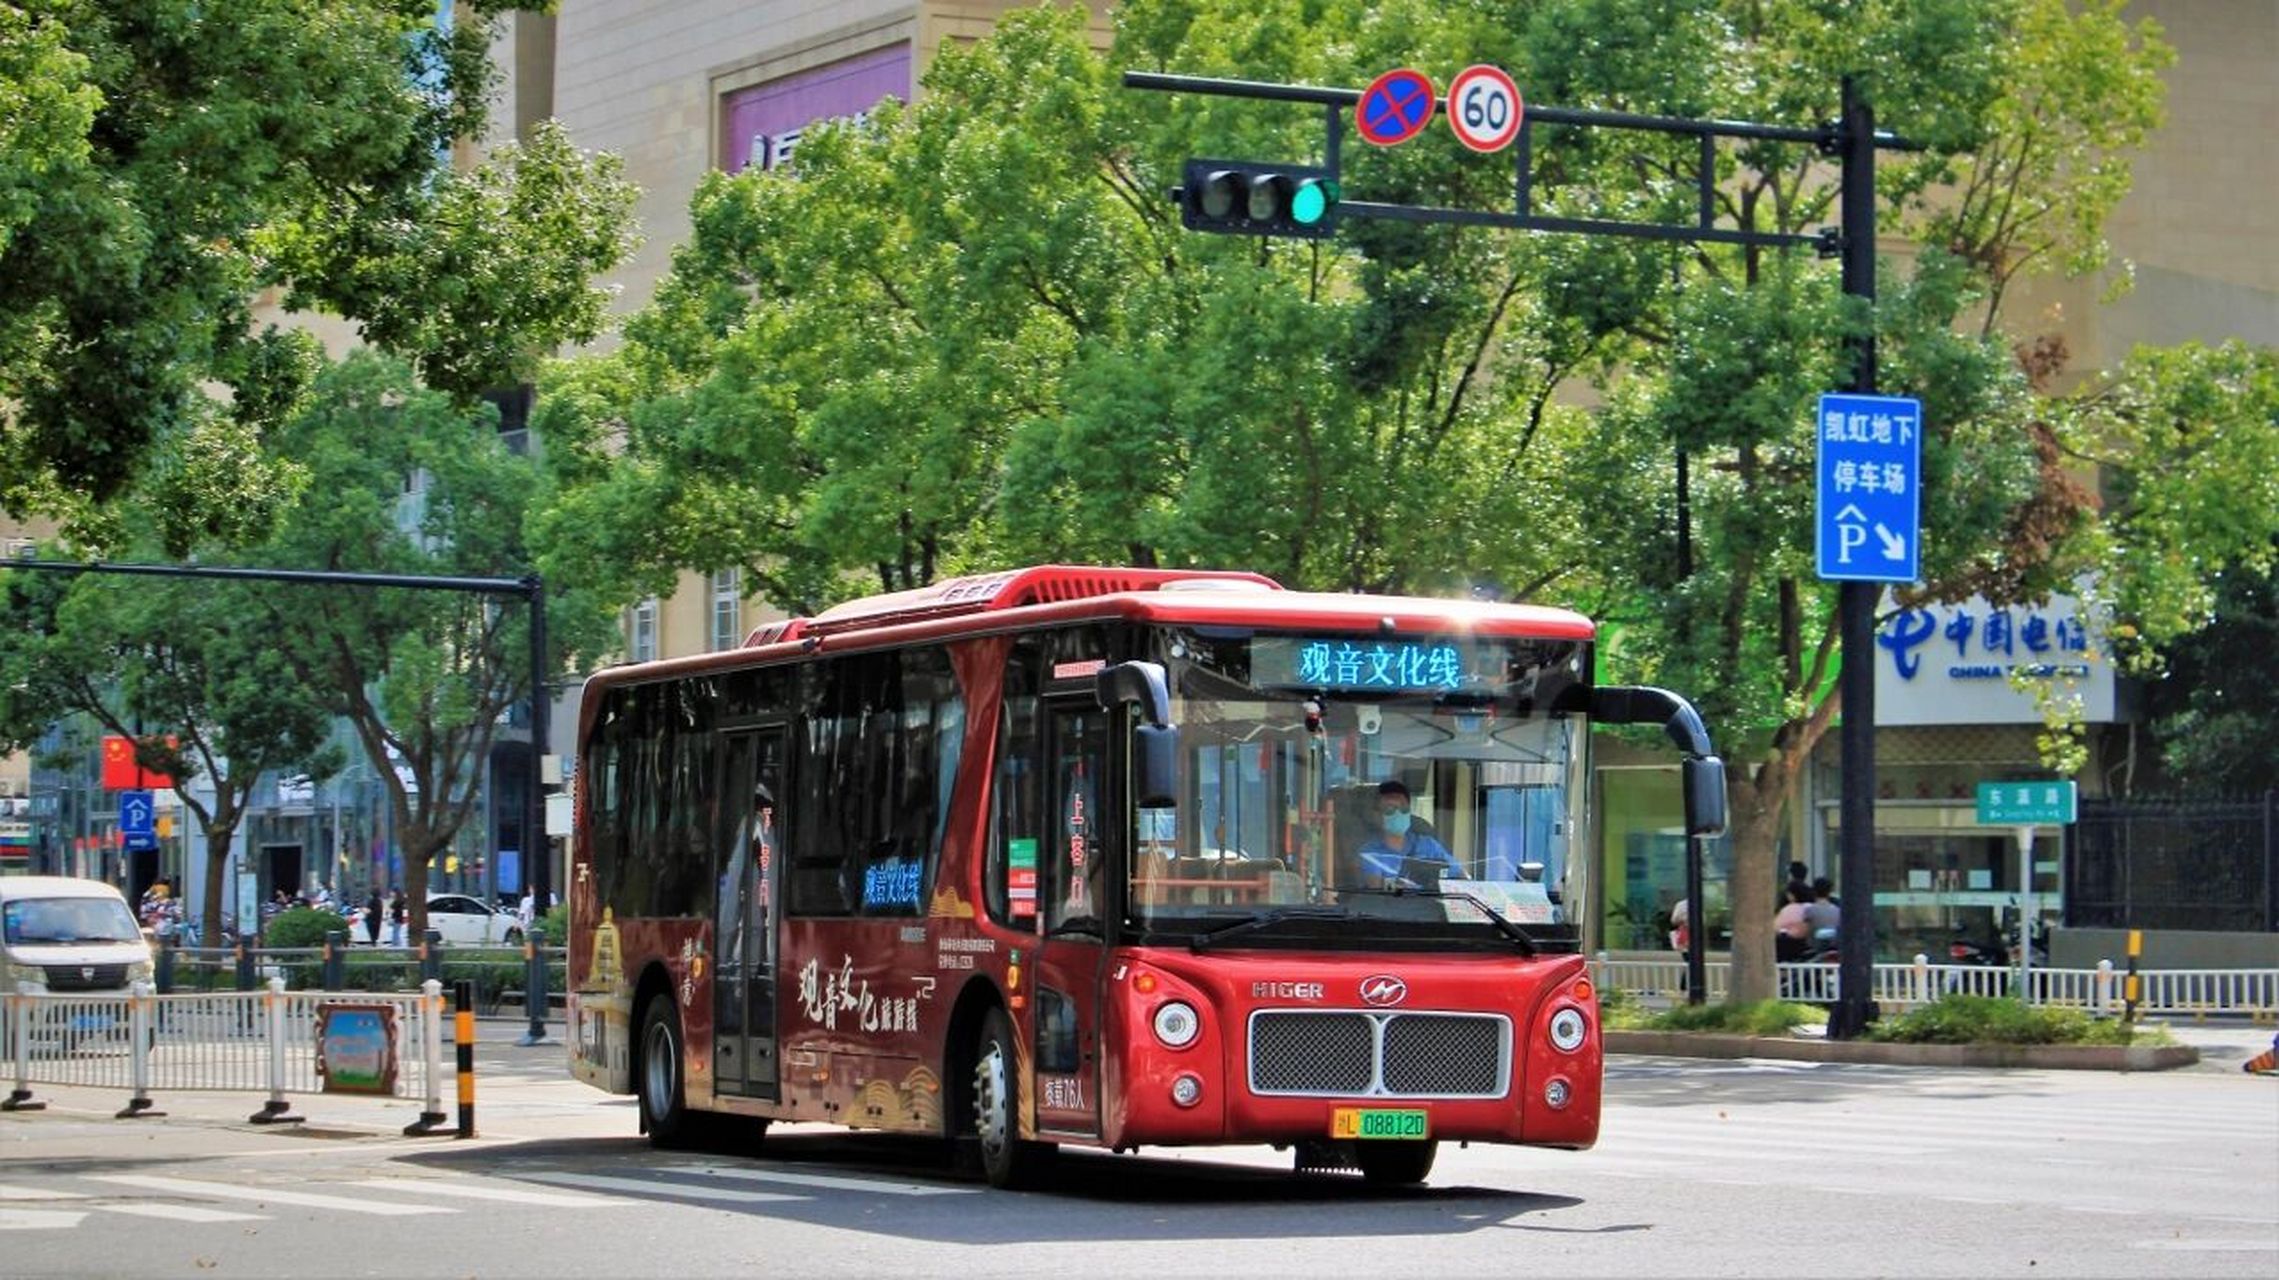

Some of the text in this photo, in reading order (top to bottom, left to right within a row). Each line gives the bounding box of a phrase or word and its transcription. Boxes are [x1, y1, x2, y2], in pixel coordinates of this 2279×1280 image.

[1464, 86, 1508, 131] 60
[1824, 411, 1915, 446] 凯虹地下
[1833, 459, 1907, 495] 停车场
[1837, 523, 1867, 563] P
[1944, 609, 2088, 658] 中国电信
[1300, 641, 1460, 689] 观音文化线
[1949, 665, 2002, 679] CHINA
[130, 808, 146, 828] P
[1071, 793, 1085, 908] 上客门
[1252, 982, 1325, 998] HIGER
